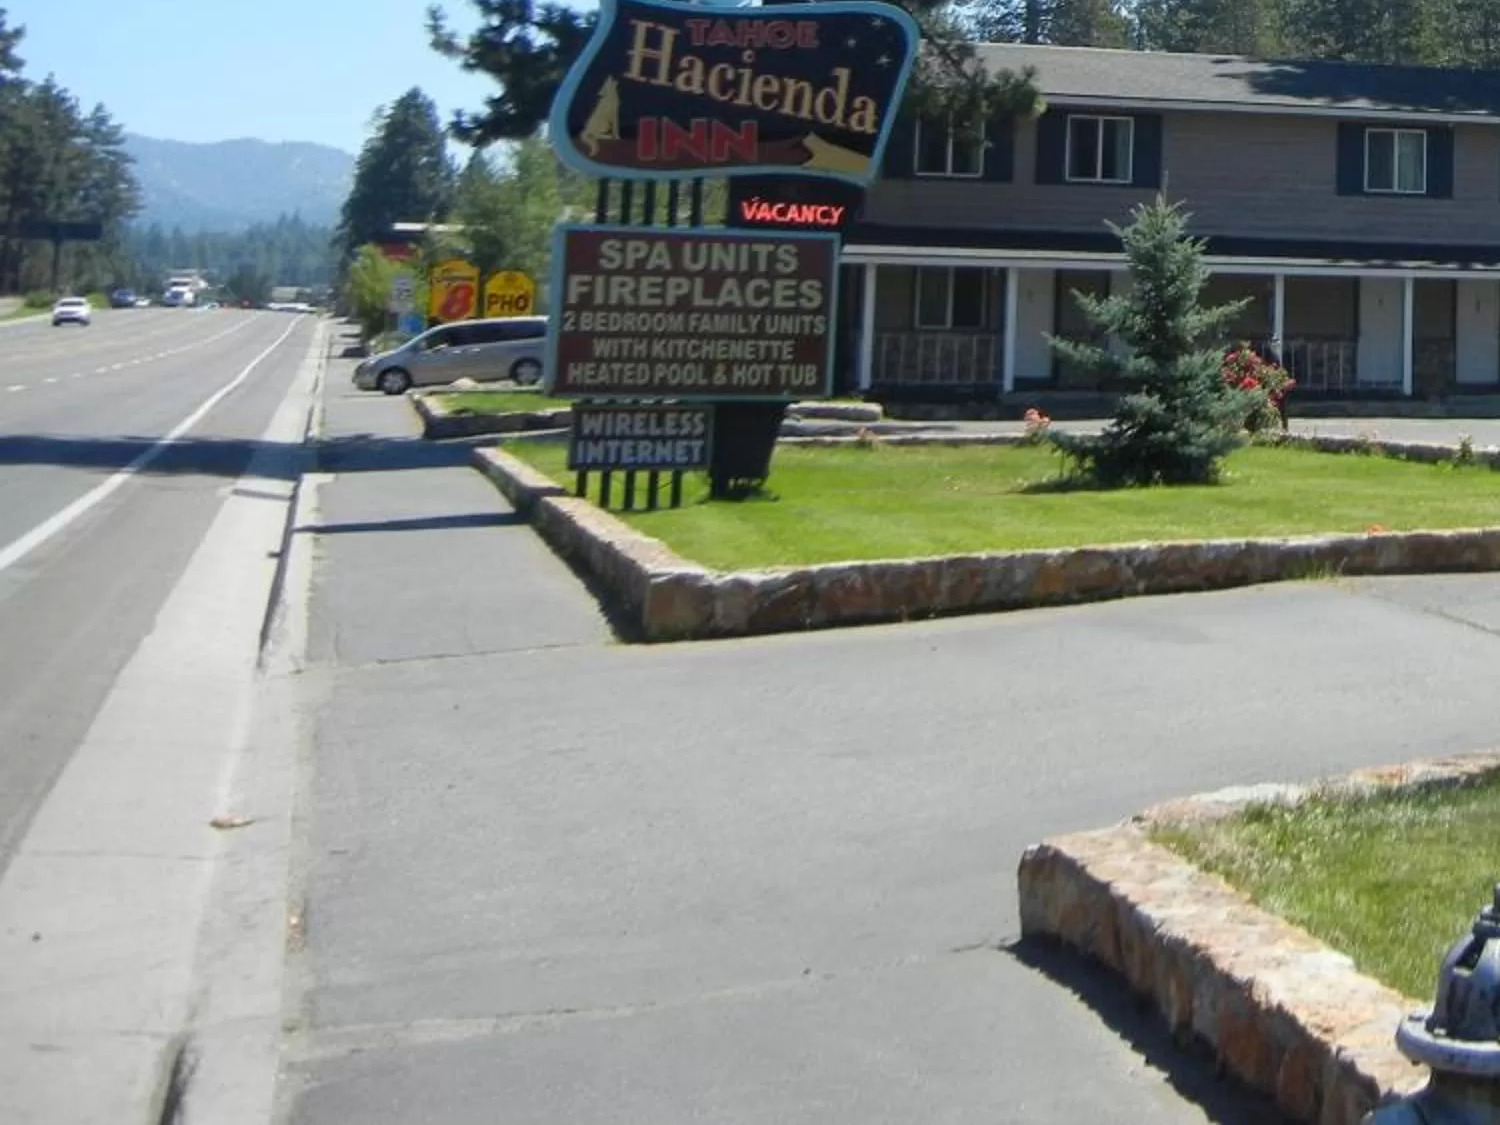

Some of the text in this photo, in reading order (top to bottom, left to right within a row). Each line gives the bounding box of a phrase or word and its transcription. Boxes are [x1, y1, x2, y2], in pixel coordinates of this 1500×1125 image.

[687, 18, 820, 48] TAHOE
[622, 18, 880, 135] Hacienda
[637, 117, 759, 163] INN
[739, 199, 844, 225] VACANCY
[600, 240, 799, 274] SPA UNITS
[487, 291, 530, 312] PHO
[566, 275, 824, 309] FIREPLACES
[563, 311, 828, 336] 2 BEDROOM FAMILY UNITS
[592, 338, 797, 361] WITH KITCHENETTE
[567, 362, 819, 387] HEATED POOL & HOT TUB
[581, 411, 705, 435] WIRELESS
[575, 439, 704, 463] INTERNET
